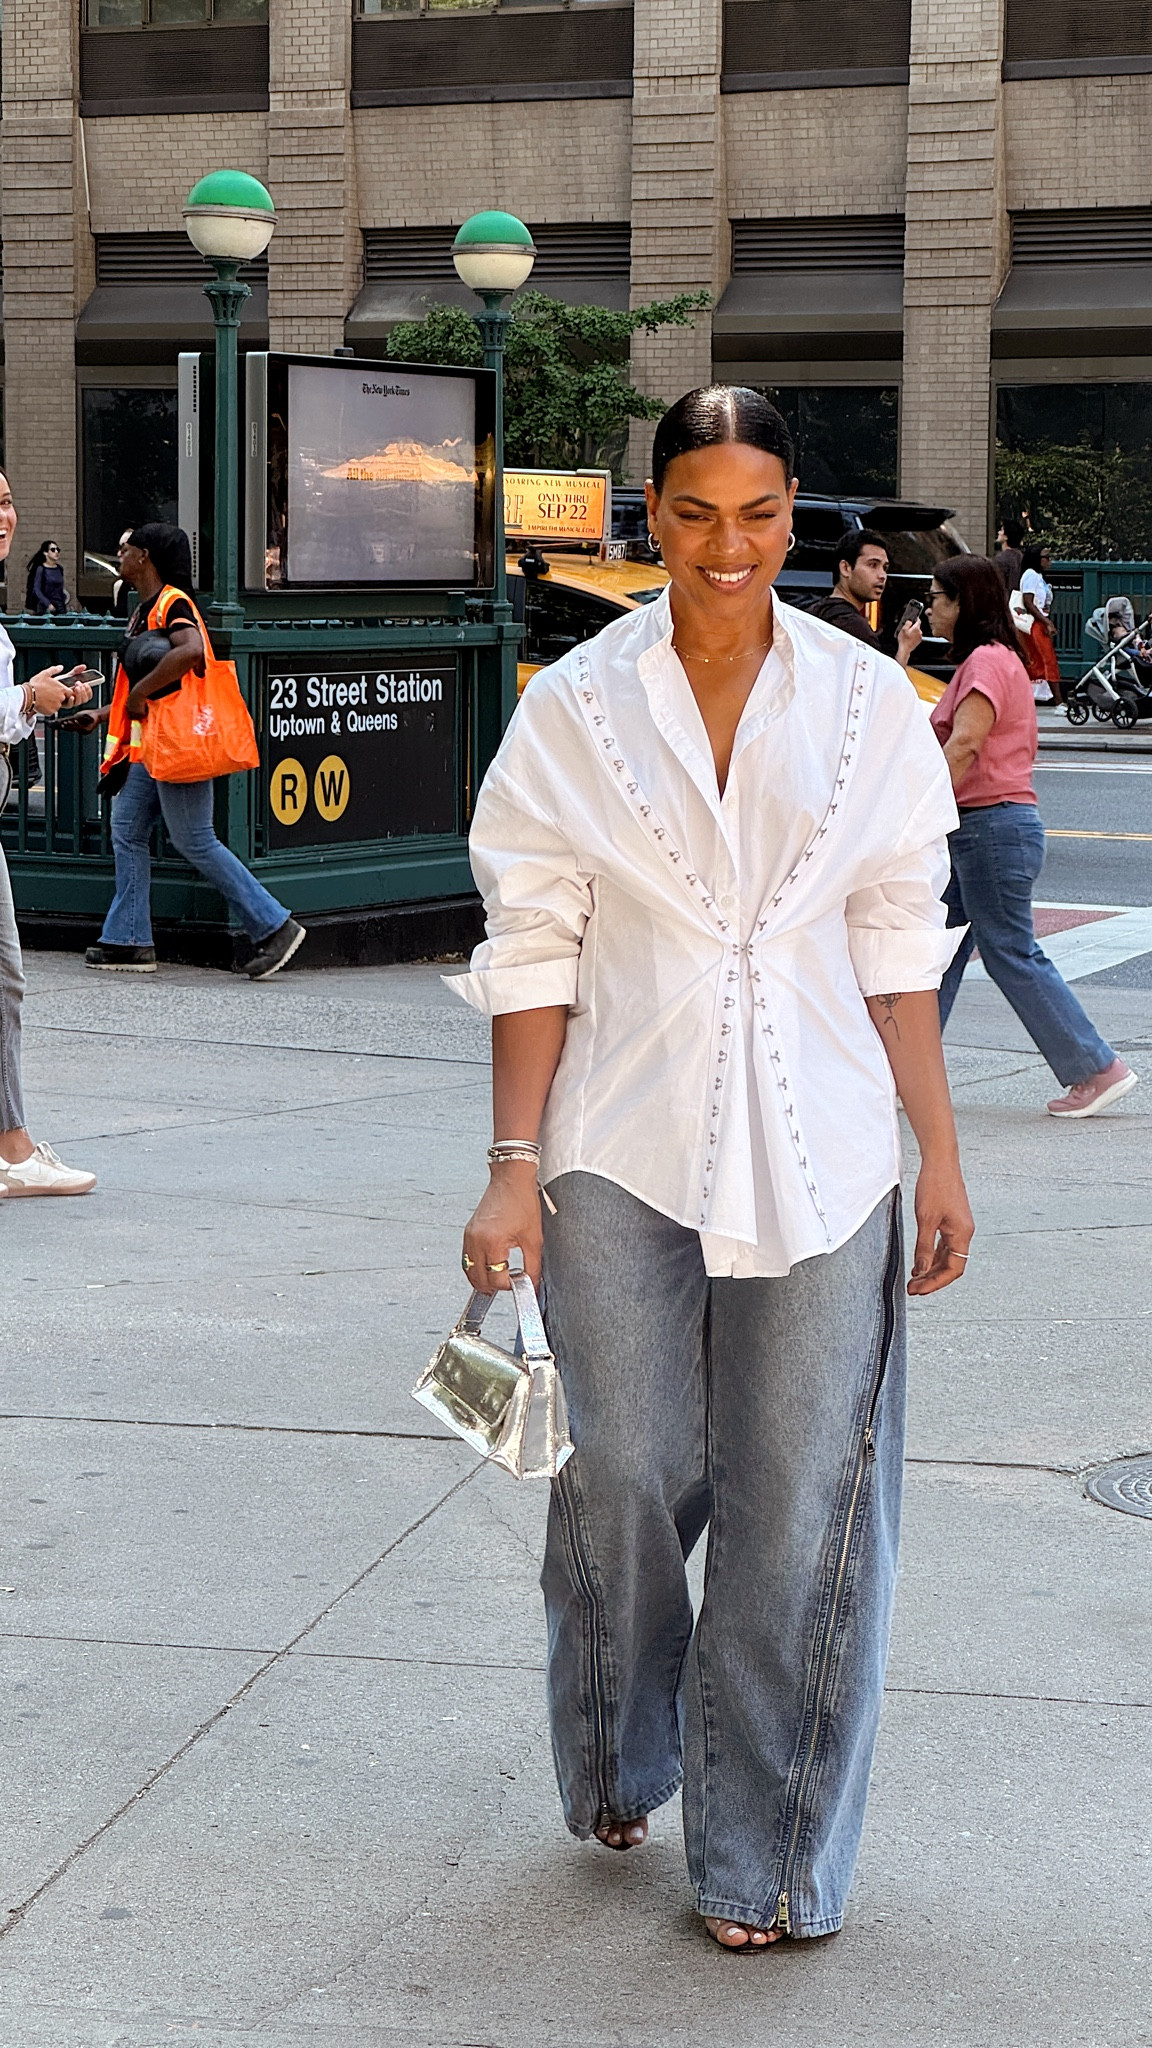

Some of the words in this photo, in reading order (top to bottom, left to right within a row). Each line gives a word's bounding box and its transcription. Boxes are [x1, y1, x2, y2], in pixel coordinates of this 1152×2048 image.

[362, 383, 372, 394] The
[372, 384, 383, 394] New
[383, 384, 395, 397] York
[505, 477, 541, 486] SOARING
[545, 479, 563, 487] NEW
[566, 480, 601, 489] MUSICAL
[538, 492, 563, 503] ONLY
[565, 494, 590, 504] THRU
[538, 503, 566, 519] SEP
[569, 504, 588, 520] 22
[270, 678, 298, 710] 23
[306, 675, 368, 708] Street
[376, 672, 443, 704] Station
[269, 714, 326, 741] Uptown
[330, 710, 341, 734] &
[346, 710, 398, 733] Queens
[280, 773, 298, 811] R
[319, 769, 345, 807] W
